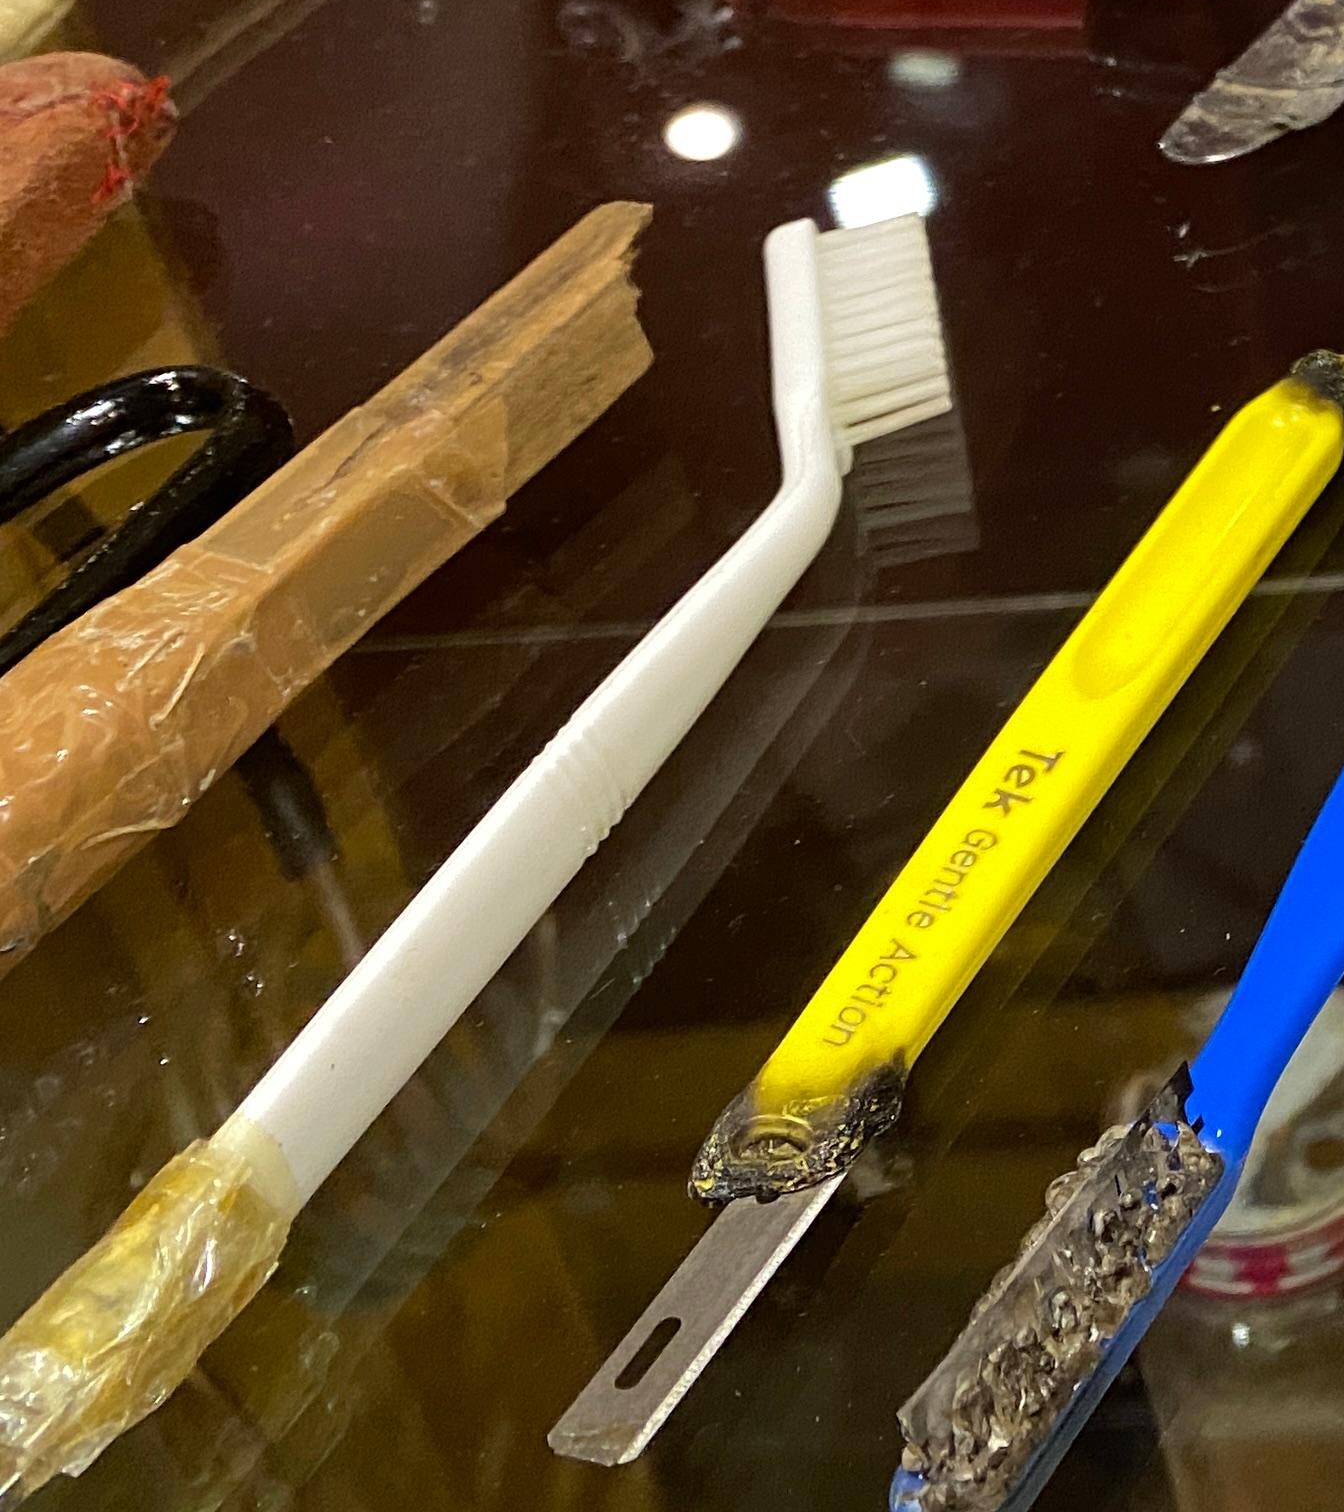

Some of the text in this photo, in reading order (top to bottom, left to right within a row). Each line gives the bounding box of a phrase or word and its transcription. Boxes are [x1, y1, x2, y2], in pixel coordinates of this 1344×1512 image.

[821, 748, 1066, 1048] Tek Gentle Action
